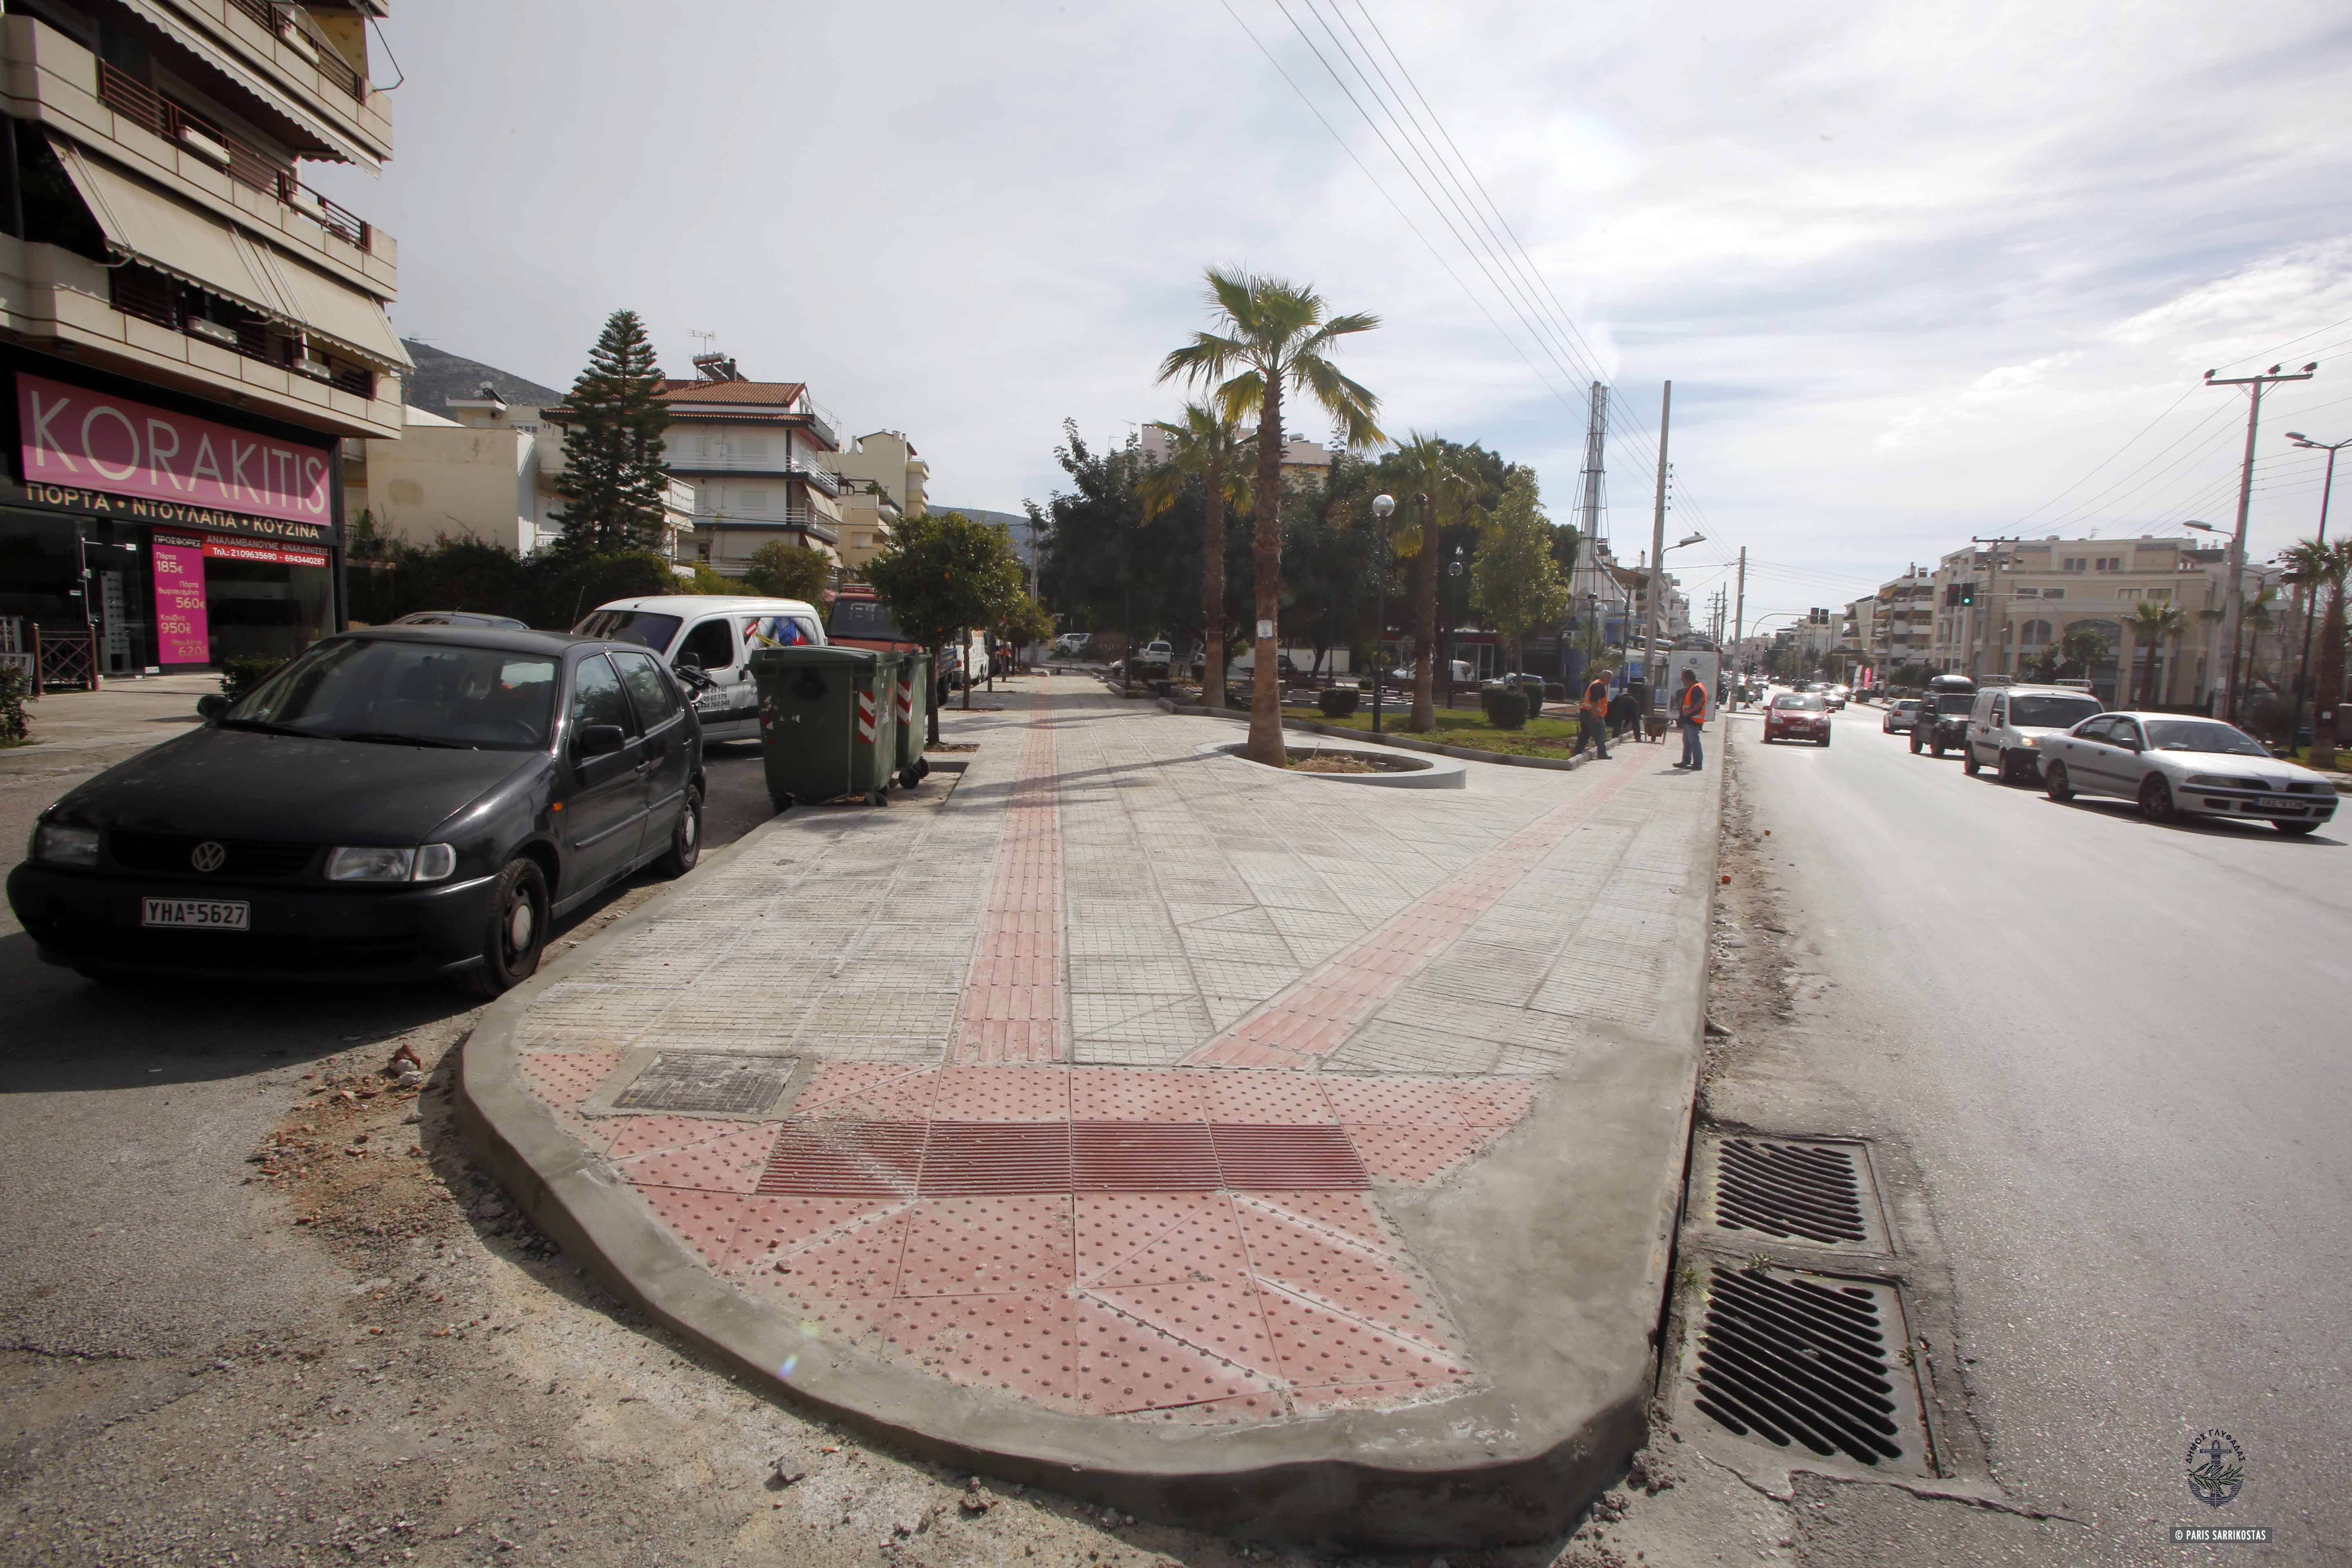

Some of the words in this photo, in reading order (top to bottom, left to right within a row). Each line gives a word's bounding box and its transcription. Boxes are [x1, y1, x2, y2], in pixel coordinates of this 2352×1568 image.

[31, 390, 326, 514] KORAKITIS
[27, 481, 111, 511] ΠΟΡΤΑ
[133, 497, 237, 529] ΝΤΟΥΛΑΠΑ
[253, 517, 319, 539] ΚΟΥΖΙΝΑ
[154, 535, 202, 548] ΠΡΟΣΦΟΡΕΣ
[207, 535, 279, 550] ΑΝΑΛΑΜΒΑΝΟΥΜΕ
[156, 552, 176, 561] Πόρτα
[231, 549, 276, 561] 2109635690
[285, 555, 325, 565] 6943440287
[157, 561, 183, 574] 185€
[180, 580, 199, 588] Πόρτα
